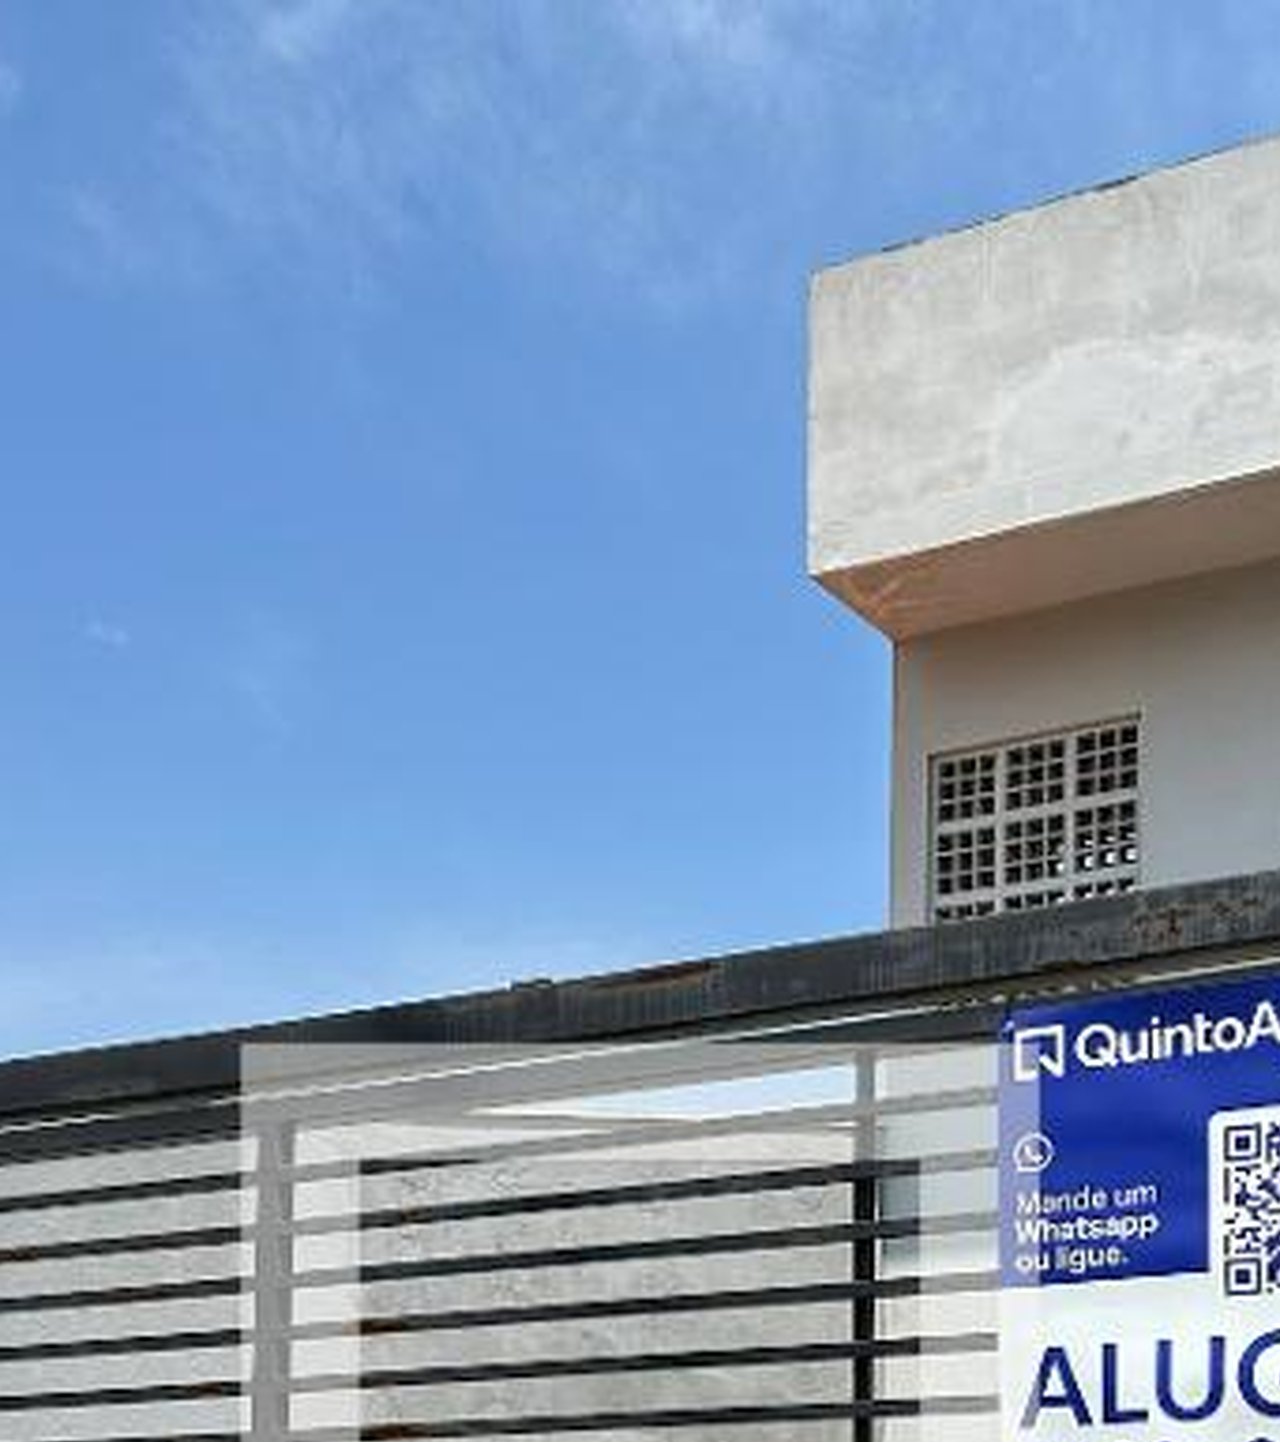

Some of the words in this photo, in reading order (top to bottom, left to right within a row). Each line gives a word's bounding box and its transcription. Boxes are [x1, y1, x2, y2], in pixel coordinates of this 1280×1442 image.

[1016, 1184, 1108, 1215] Mande
[1113, 1184, 1157, 1207] um
[1015, 1213, 1159, 1243] Whatsapp
[1015, 1252, 1050, 1273] ou
